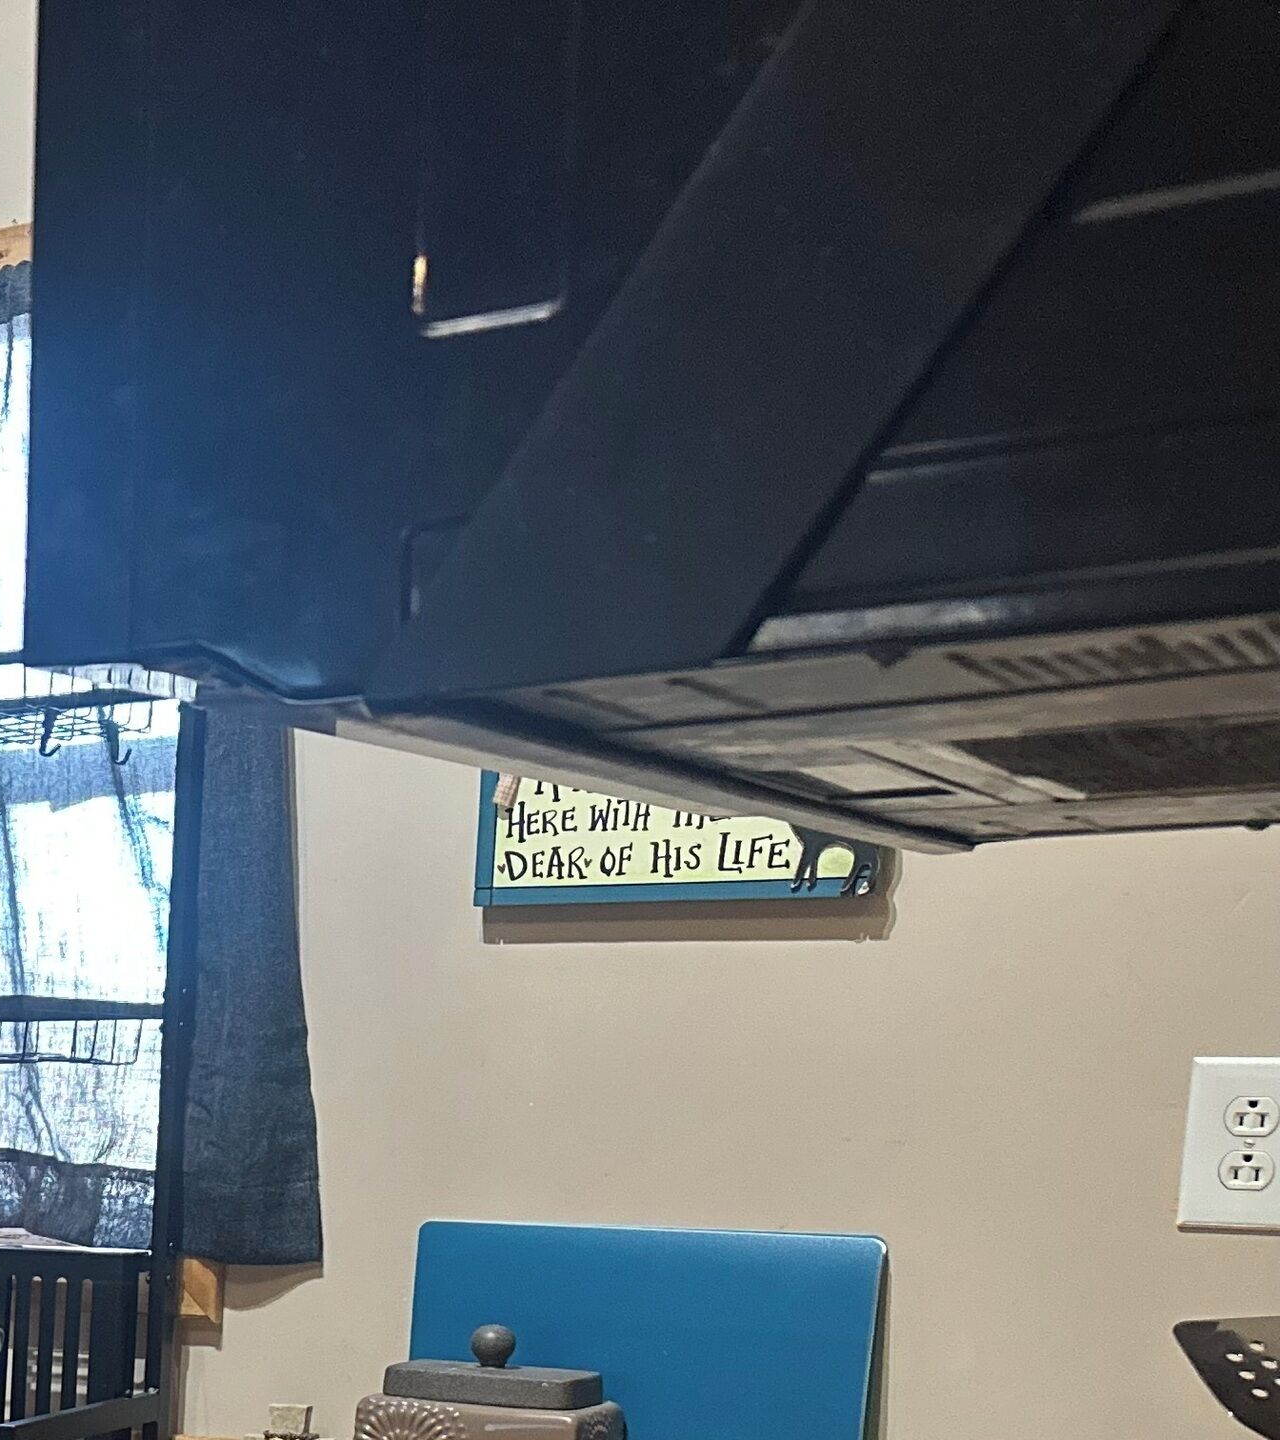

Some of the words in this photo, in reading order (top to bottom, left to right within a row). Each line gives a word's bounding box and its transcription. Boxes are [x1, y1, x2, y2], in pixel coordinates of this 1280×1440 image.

[505, 800, 578, 843] HERE
[504, 846, 588, 881] DEAR
[599, 842, 633, 877] OF
[650, 838, 702, 878] HIS
[718, 831, 792, 874] LIFE
